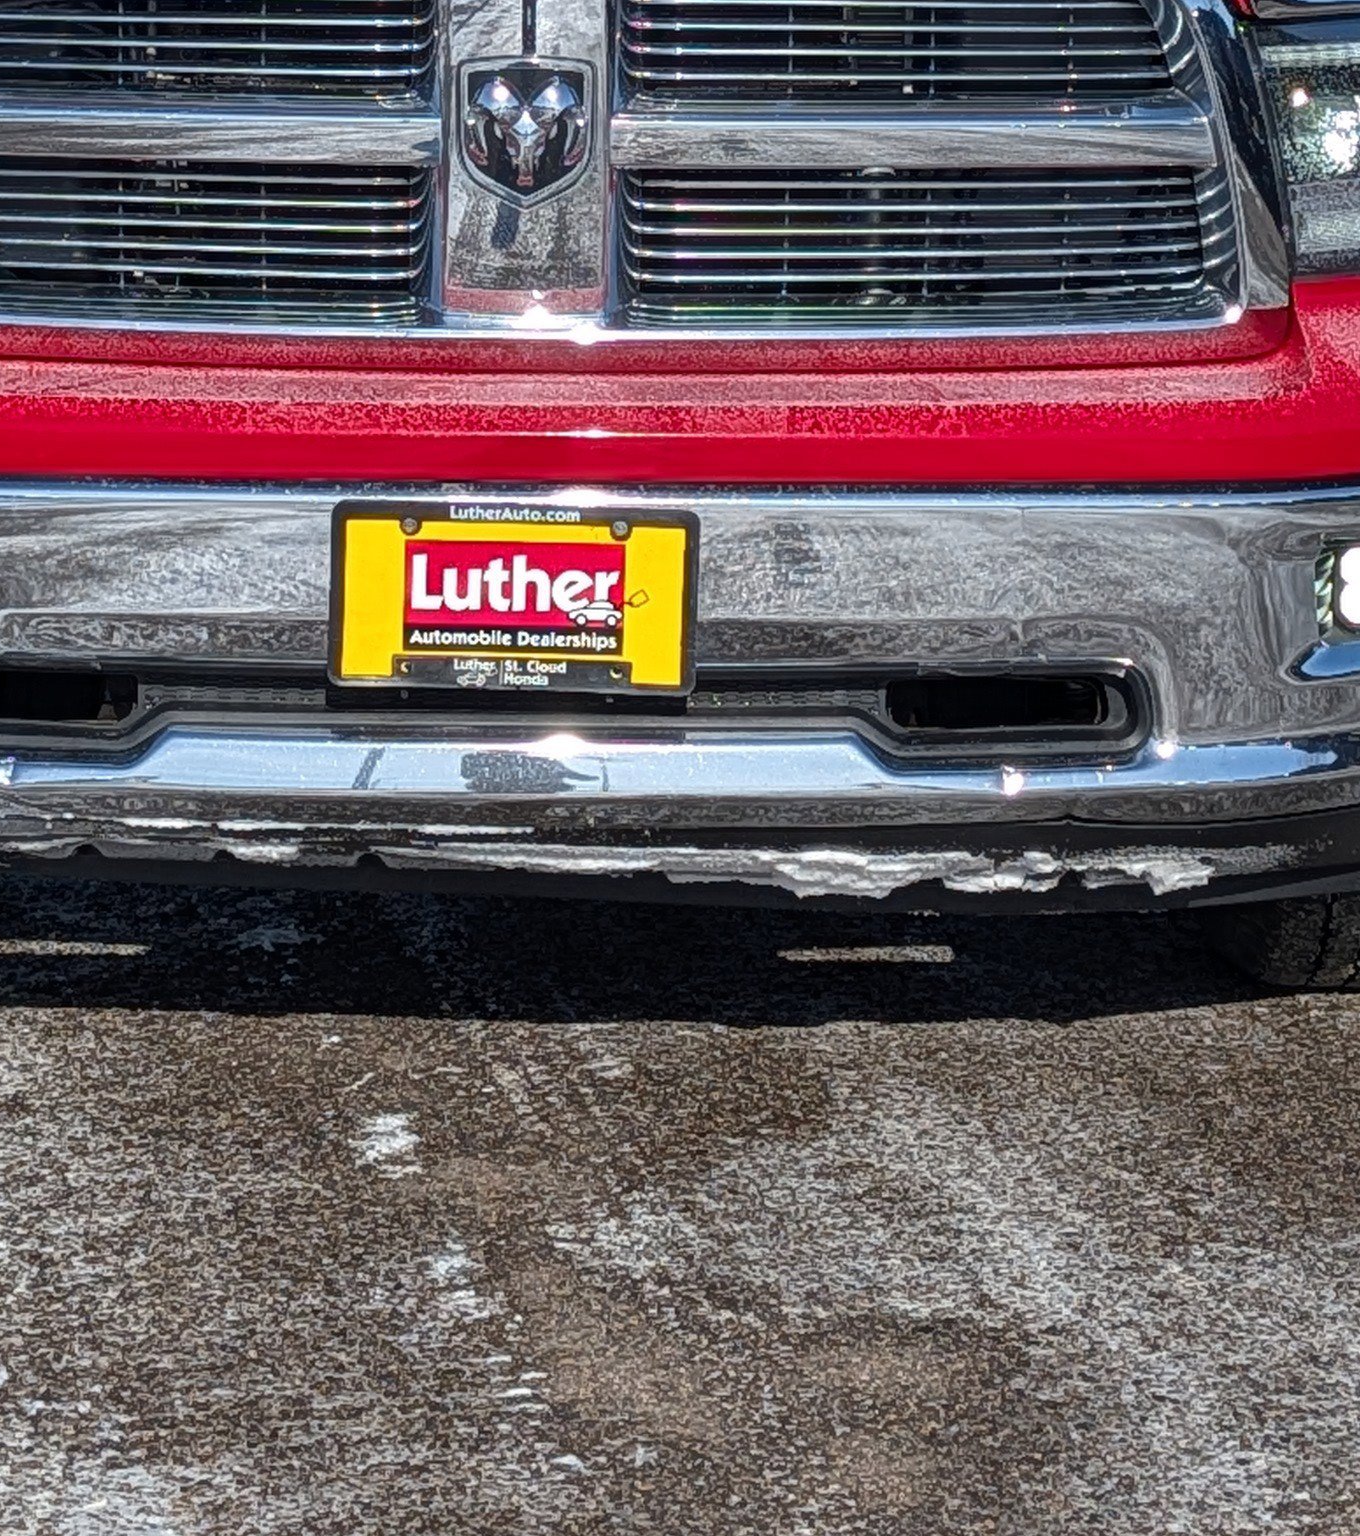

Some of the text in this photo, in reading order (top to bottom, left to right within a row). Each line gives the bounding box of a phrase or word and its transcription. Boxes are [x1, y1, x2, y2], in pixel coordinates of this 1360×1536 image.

[449, 505, 581, 523] LutherAuto.com
[411, 553, 621, 613] Luther
[409, 630, 618, 651] Automobile Dealerships
[526, 659, 567, 674] Cloud
[503, 672, 550, 686] Honda
